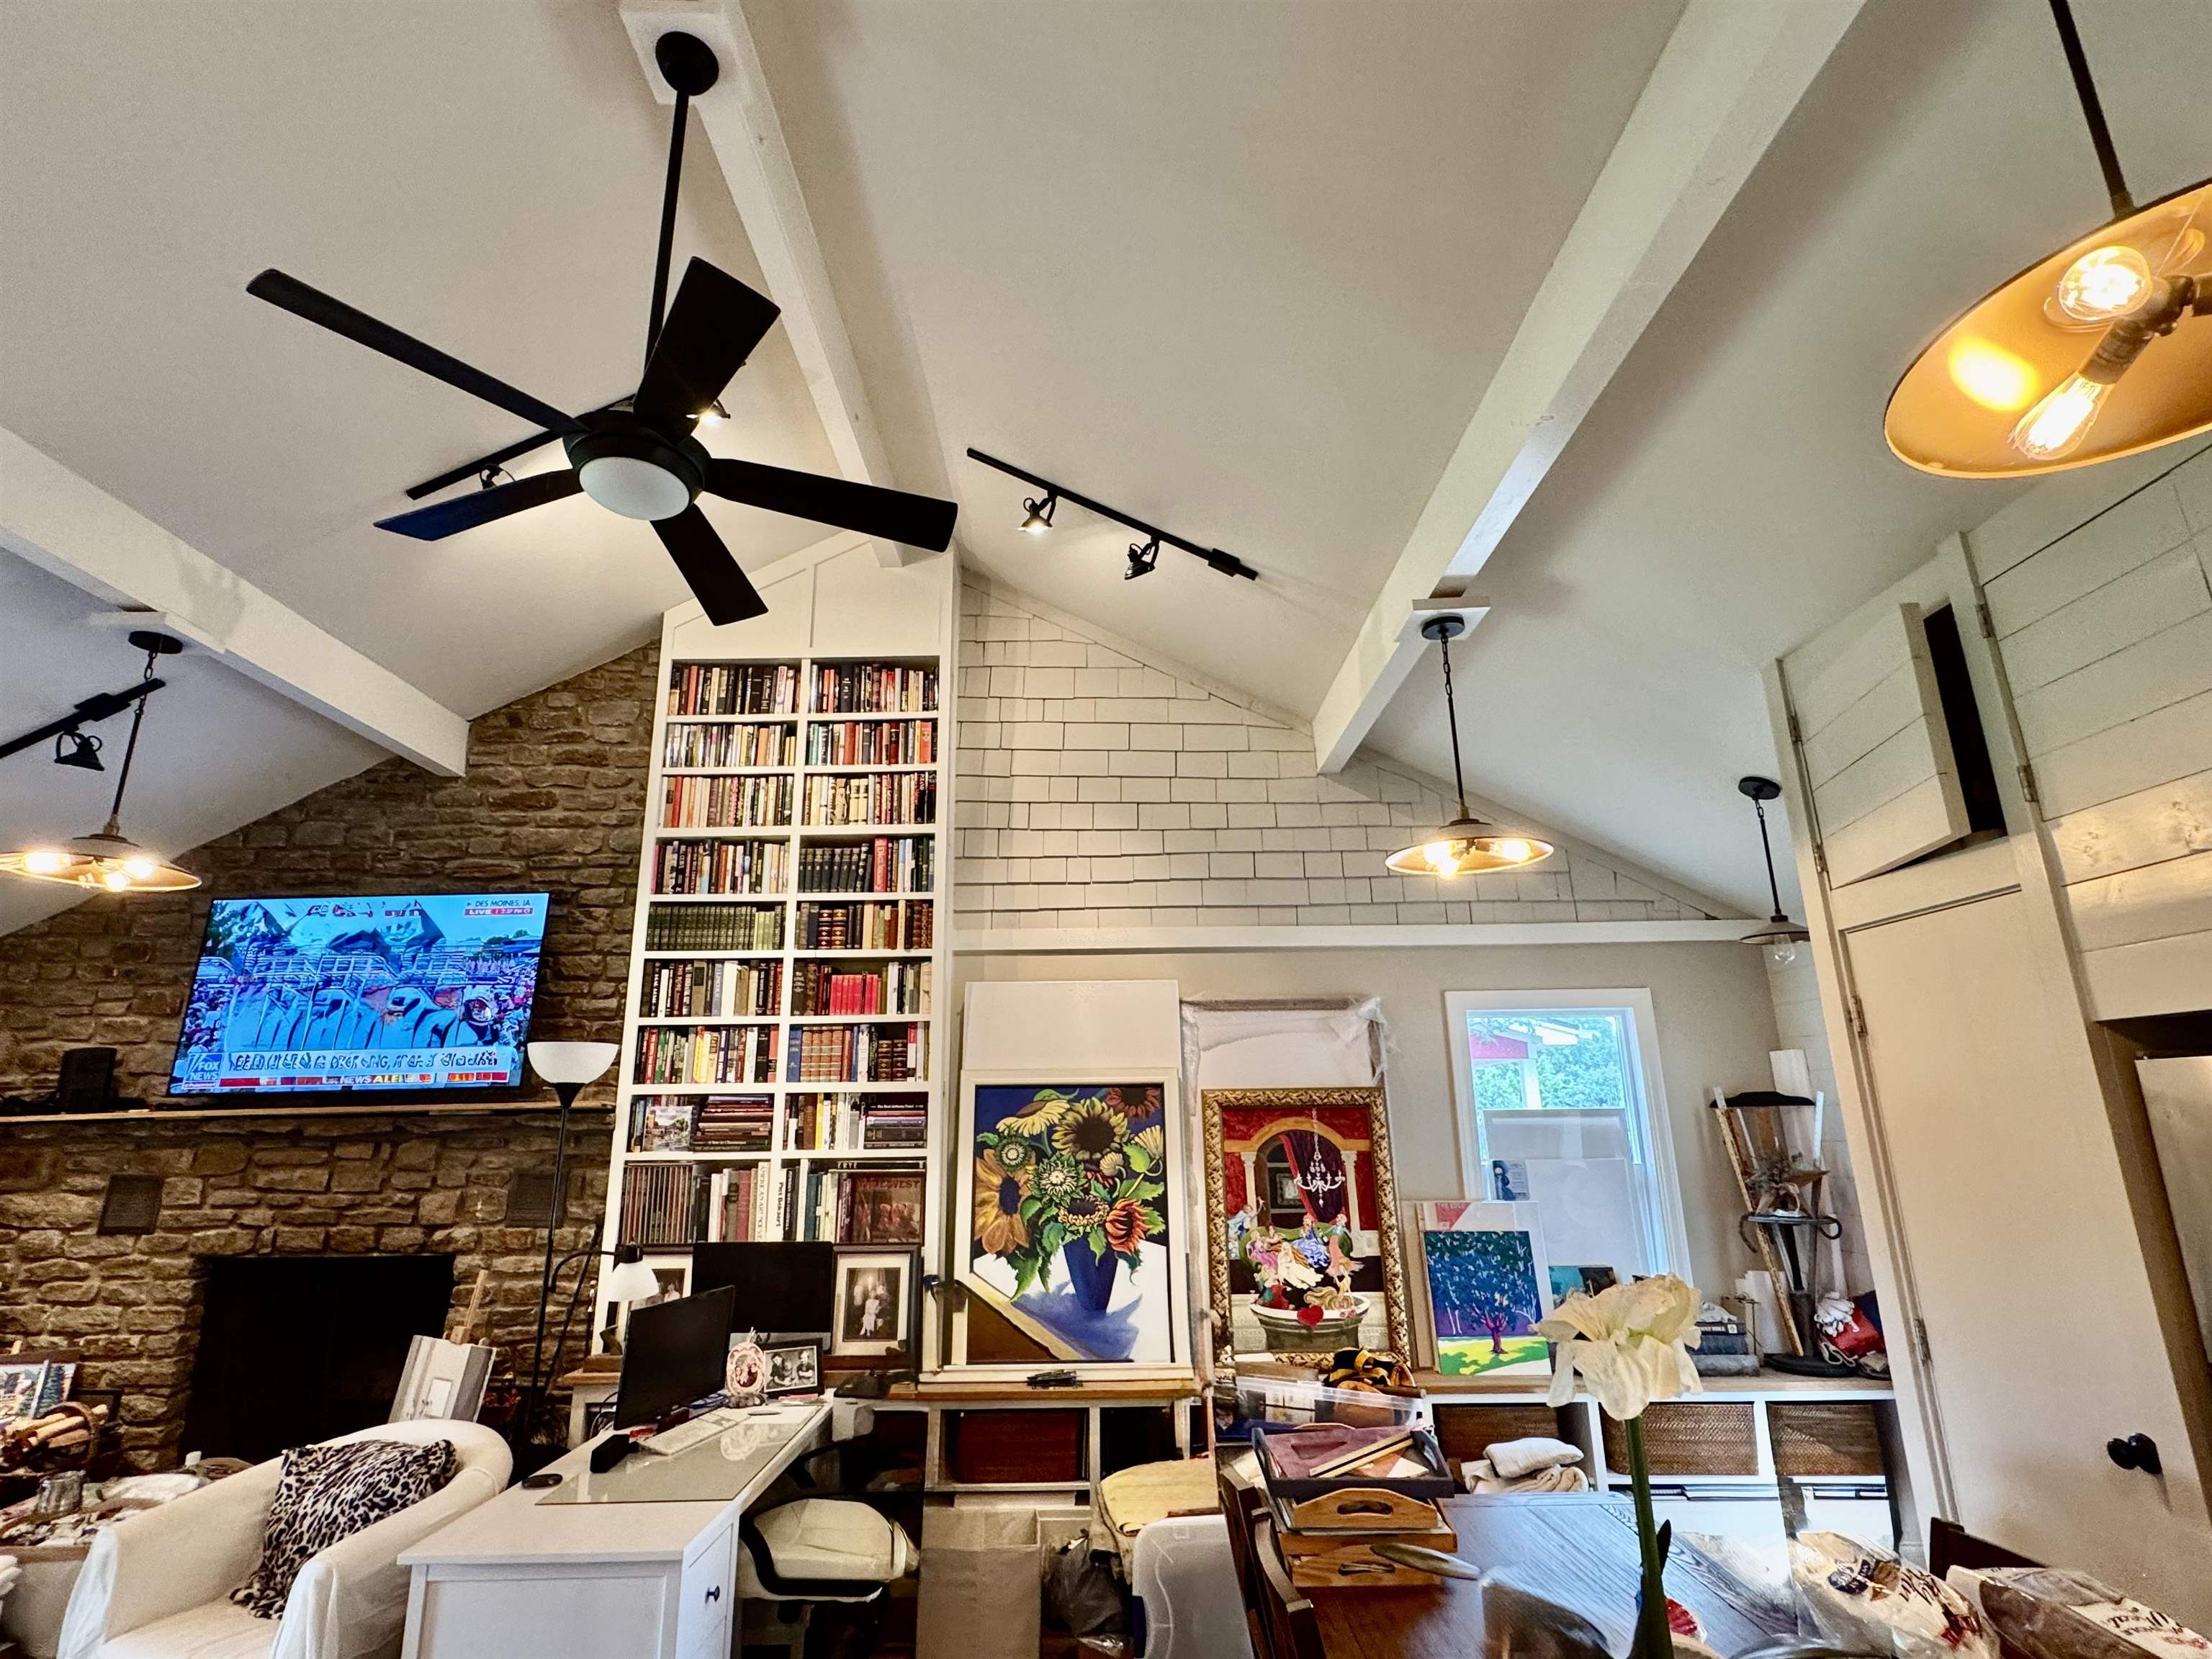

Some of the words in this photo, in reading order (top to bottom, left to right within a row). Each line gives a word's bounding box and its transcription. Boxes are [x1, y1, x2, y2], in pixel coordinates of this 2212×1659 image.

[197, 1061, 220, 1071] FOX
[189, 1071, 218, 1081] NEWS
[340, 1075, 372, 1084] NEWS
